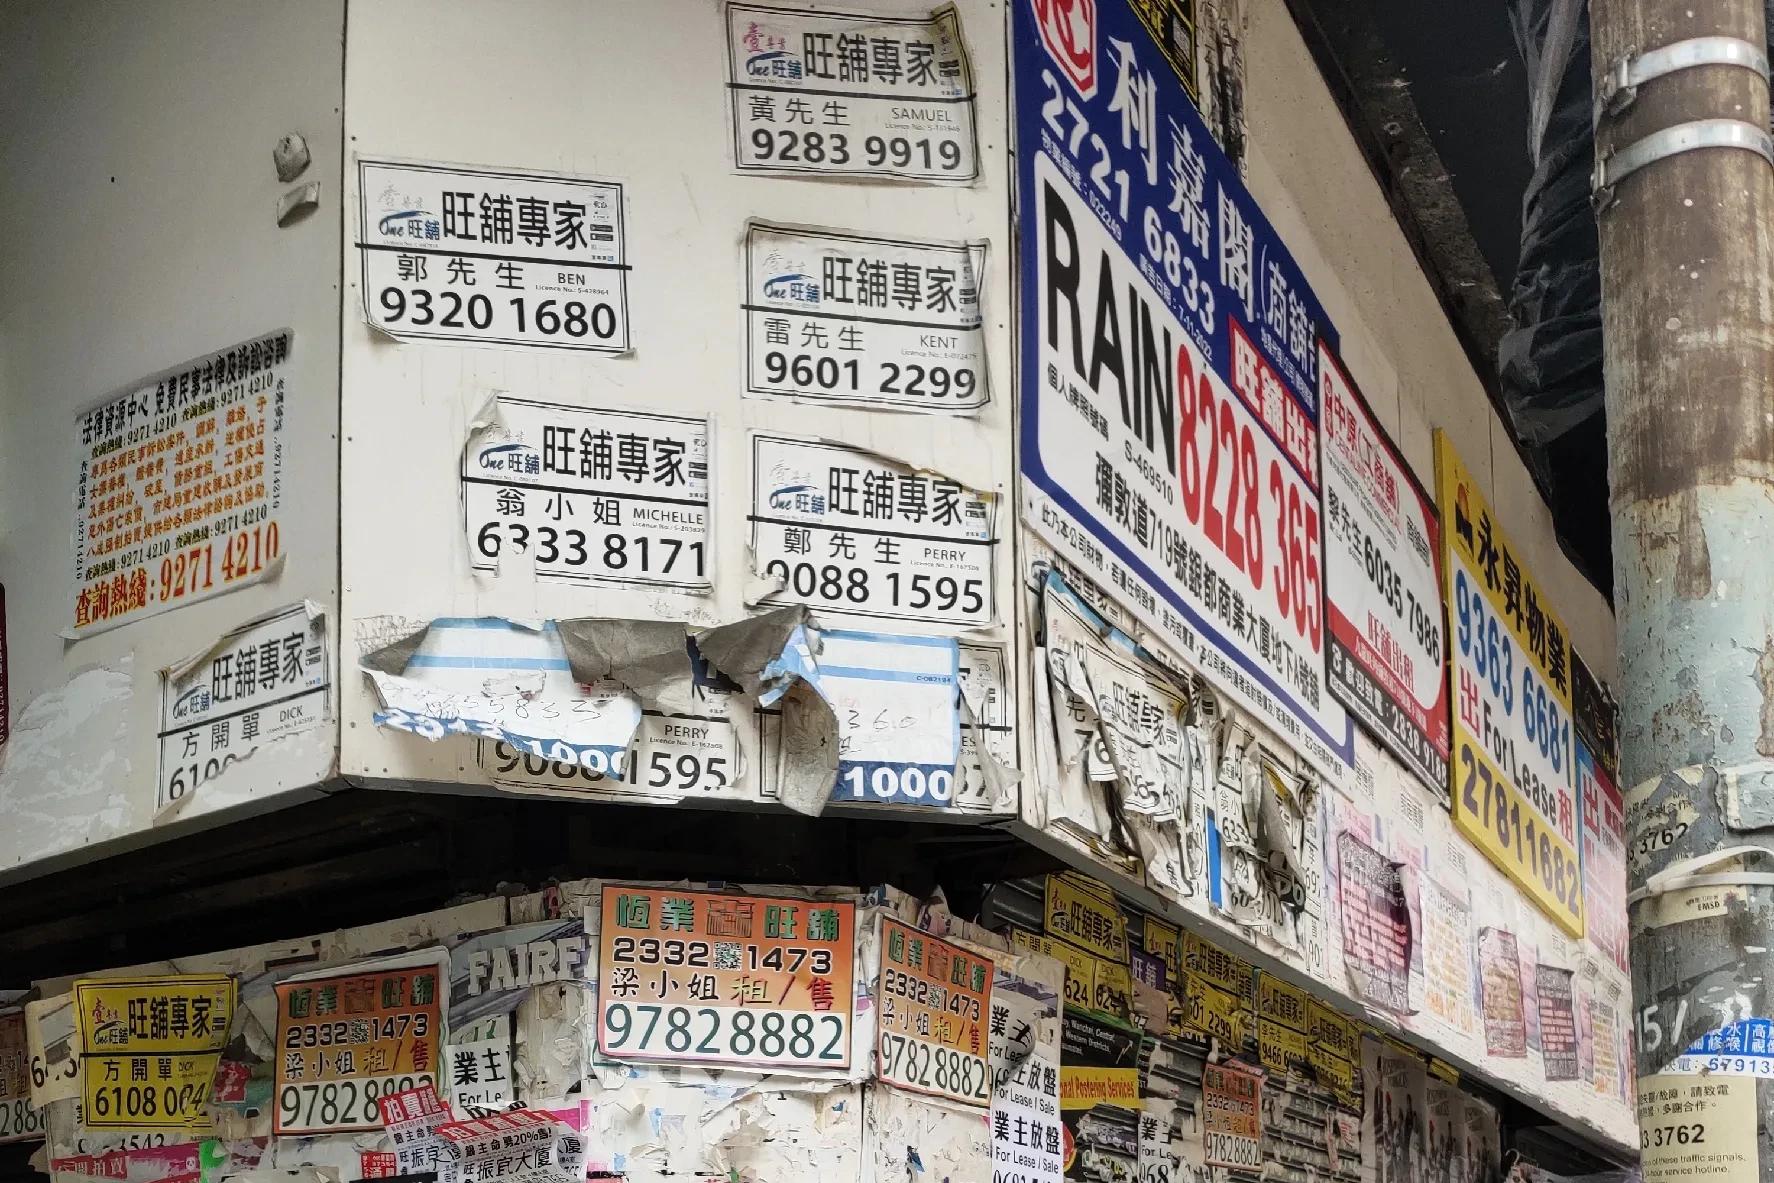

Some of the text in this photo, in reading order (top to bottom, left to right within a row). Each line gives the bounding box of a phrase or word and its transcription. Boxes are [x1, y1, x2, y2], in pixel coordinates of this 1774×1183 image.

[803, 32, 938, 87] 旺舖專家
[890, 106, 954, 123] SAMUEL
[751, 128, 961, 171] 9283 9919
[1105, 34, 1256, 322] 利嘉閣
[441, 190, 588, 251] 旺舖專家
[1041, 69, 1216, 335] 2721 6833
[397, 253, 526, 291] 郭先生
[556, 271, 587, 287] BEN
[822, 256, 957, 313] 旺舖專家
[379, 286, 617, 340] 9320 1680
[1044, 177, 1176, 478] RAIN
[764, 317, 866, 352] 雷先生
[919, 334, 959, 349] KENT
[765, 351, 976, 399] 9601 2299
[542, 424, 687, 487] 旺舖專家
[1123, 438, 1174, 507] S-469510
[1176, 343, 1263, 590] 8228
[495, 488, 622, 527] 翁小姐
[632, 507, 704, 526] MICHELLE
[828, 466, 963, 527] 旺舖專家
[220, 520, 281, 582] 4210
[477, 521, 704, 577] 6333 8171
[923, 547, 967, 562] PERRY
[885, 572, 984, 614] 1595
[1364, 535, 1404, 620] 6035
[1406, 588, 1440, 668] 7986
[1476, 509, 1568, 698] 永昇物業
[211, 631, 305, 705] 旺舖專家
[1368, 609, 1416, 696] 旺舖出租
[1455, 569, 1572, 788] 9363 6681
[279, 705, 303, 723] DICK
[664, 724, 709, 740] PERRY
[1458, 664, 1576, 848] 出 For Lease 租
[843, 766, 954, 803] 1000
[1639, 821, 1690, 855] 3762
[763, 904, 840, 942] 旺舖
[1070, 900, 1115, 952] 旺舖專家
[1697, 901, 1722, 912] EMSD
[612, 936, 834, 976] 2332 1473
[610, 966, 719, 1002] 梁小姐
[884, 968, 981, 1023] 2332 1473
[1064, 975, 1089, 1007] 624
[127, 994, 213, 1041] 旺舖專家
[286, 1012, 429, 1050] 2332 1473
[1208, 1010, 1233, 1041] 2299
[284, 1050, 356, 1082] 梁小姐
[94, 1085, 157, 1117] 6108
[1010, 1089, 1032, 1110] Lease
[1039, 1097, 1055, 1117] Sale
[1106, 1076, 1135, 1099] Services
[992, 1109, 1061, 1157] 業主放盤
[1654, 1123, 1706, 1147] 3762
[995, 1146, 1060, 1175] For Lease Sale
